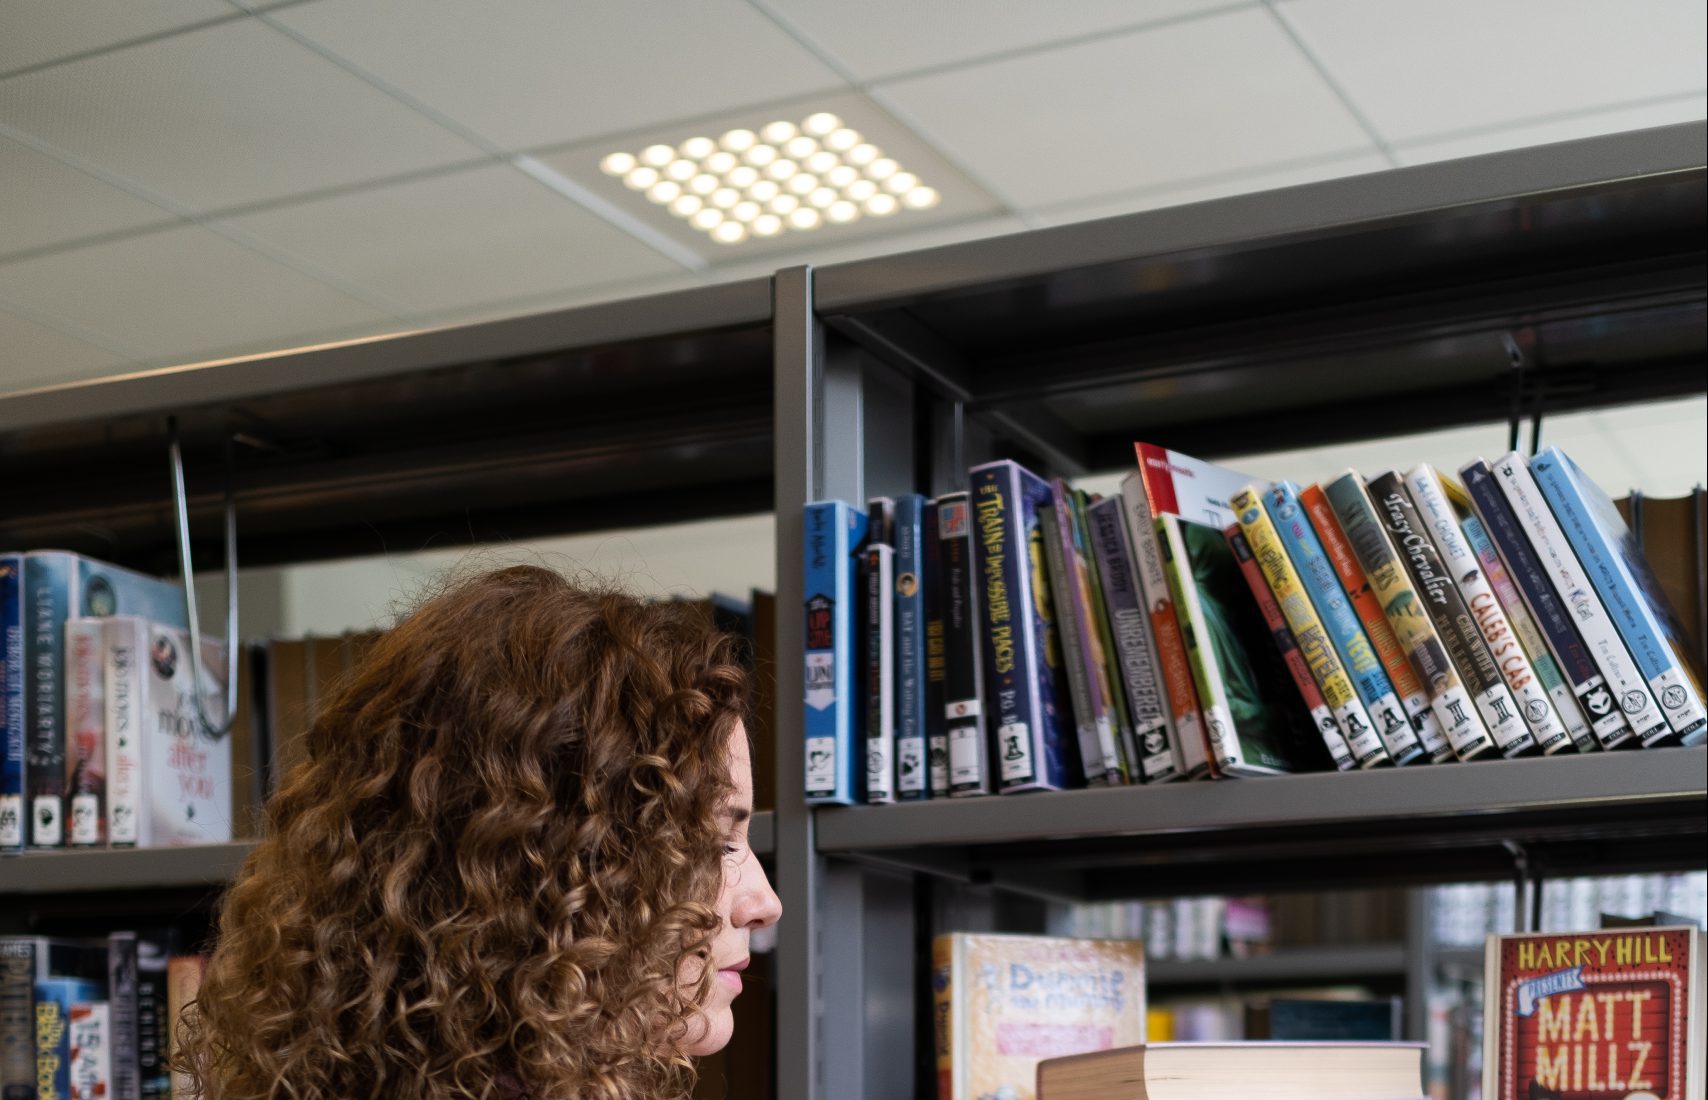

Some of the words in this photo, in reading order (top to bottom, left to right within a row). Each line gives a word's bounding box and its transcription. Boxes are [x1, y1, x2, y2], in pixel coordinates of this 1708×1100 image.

[975, 492, 1006, 545] TRAIN
[1433, 517, 1466, 563] CHOMET
[1373, 488, 1422, 542] Tracy
[1398, 528, 1459, 609] Chevalier
[983, 554, 1010, 624] IMPOSSIBLE
[36, 588, 54, 644] LIANE
[1466, 589, 1518, 658] CALEB'S
[1498, 653, 1534, 693] CAB
[987, 626, 1014, 674] PLACES
[1113, 606, 1162, 723] UNREMEMBERED
[36, 653, 54, 753] MORIARTY
[1517, 937, 1613, 971] HARRY
[1615, 935, 1673, 966] HILL
[1528, 972, 1578, 998] PRESENTS
[1537, 992, 1652, 1042] MATT
[1536, 1044, 1653, 1091] MILLZ
